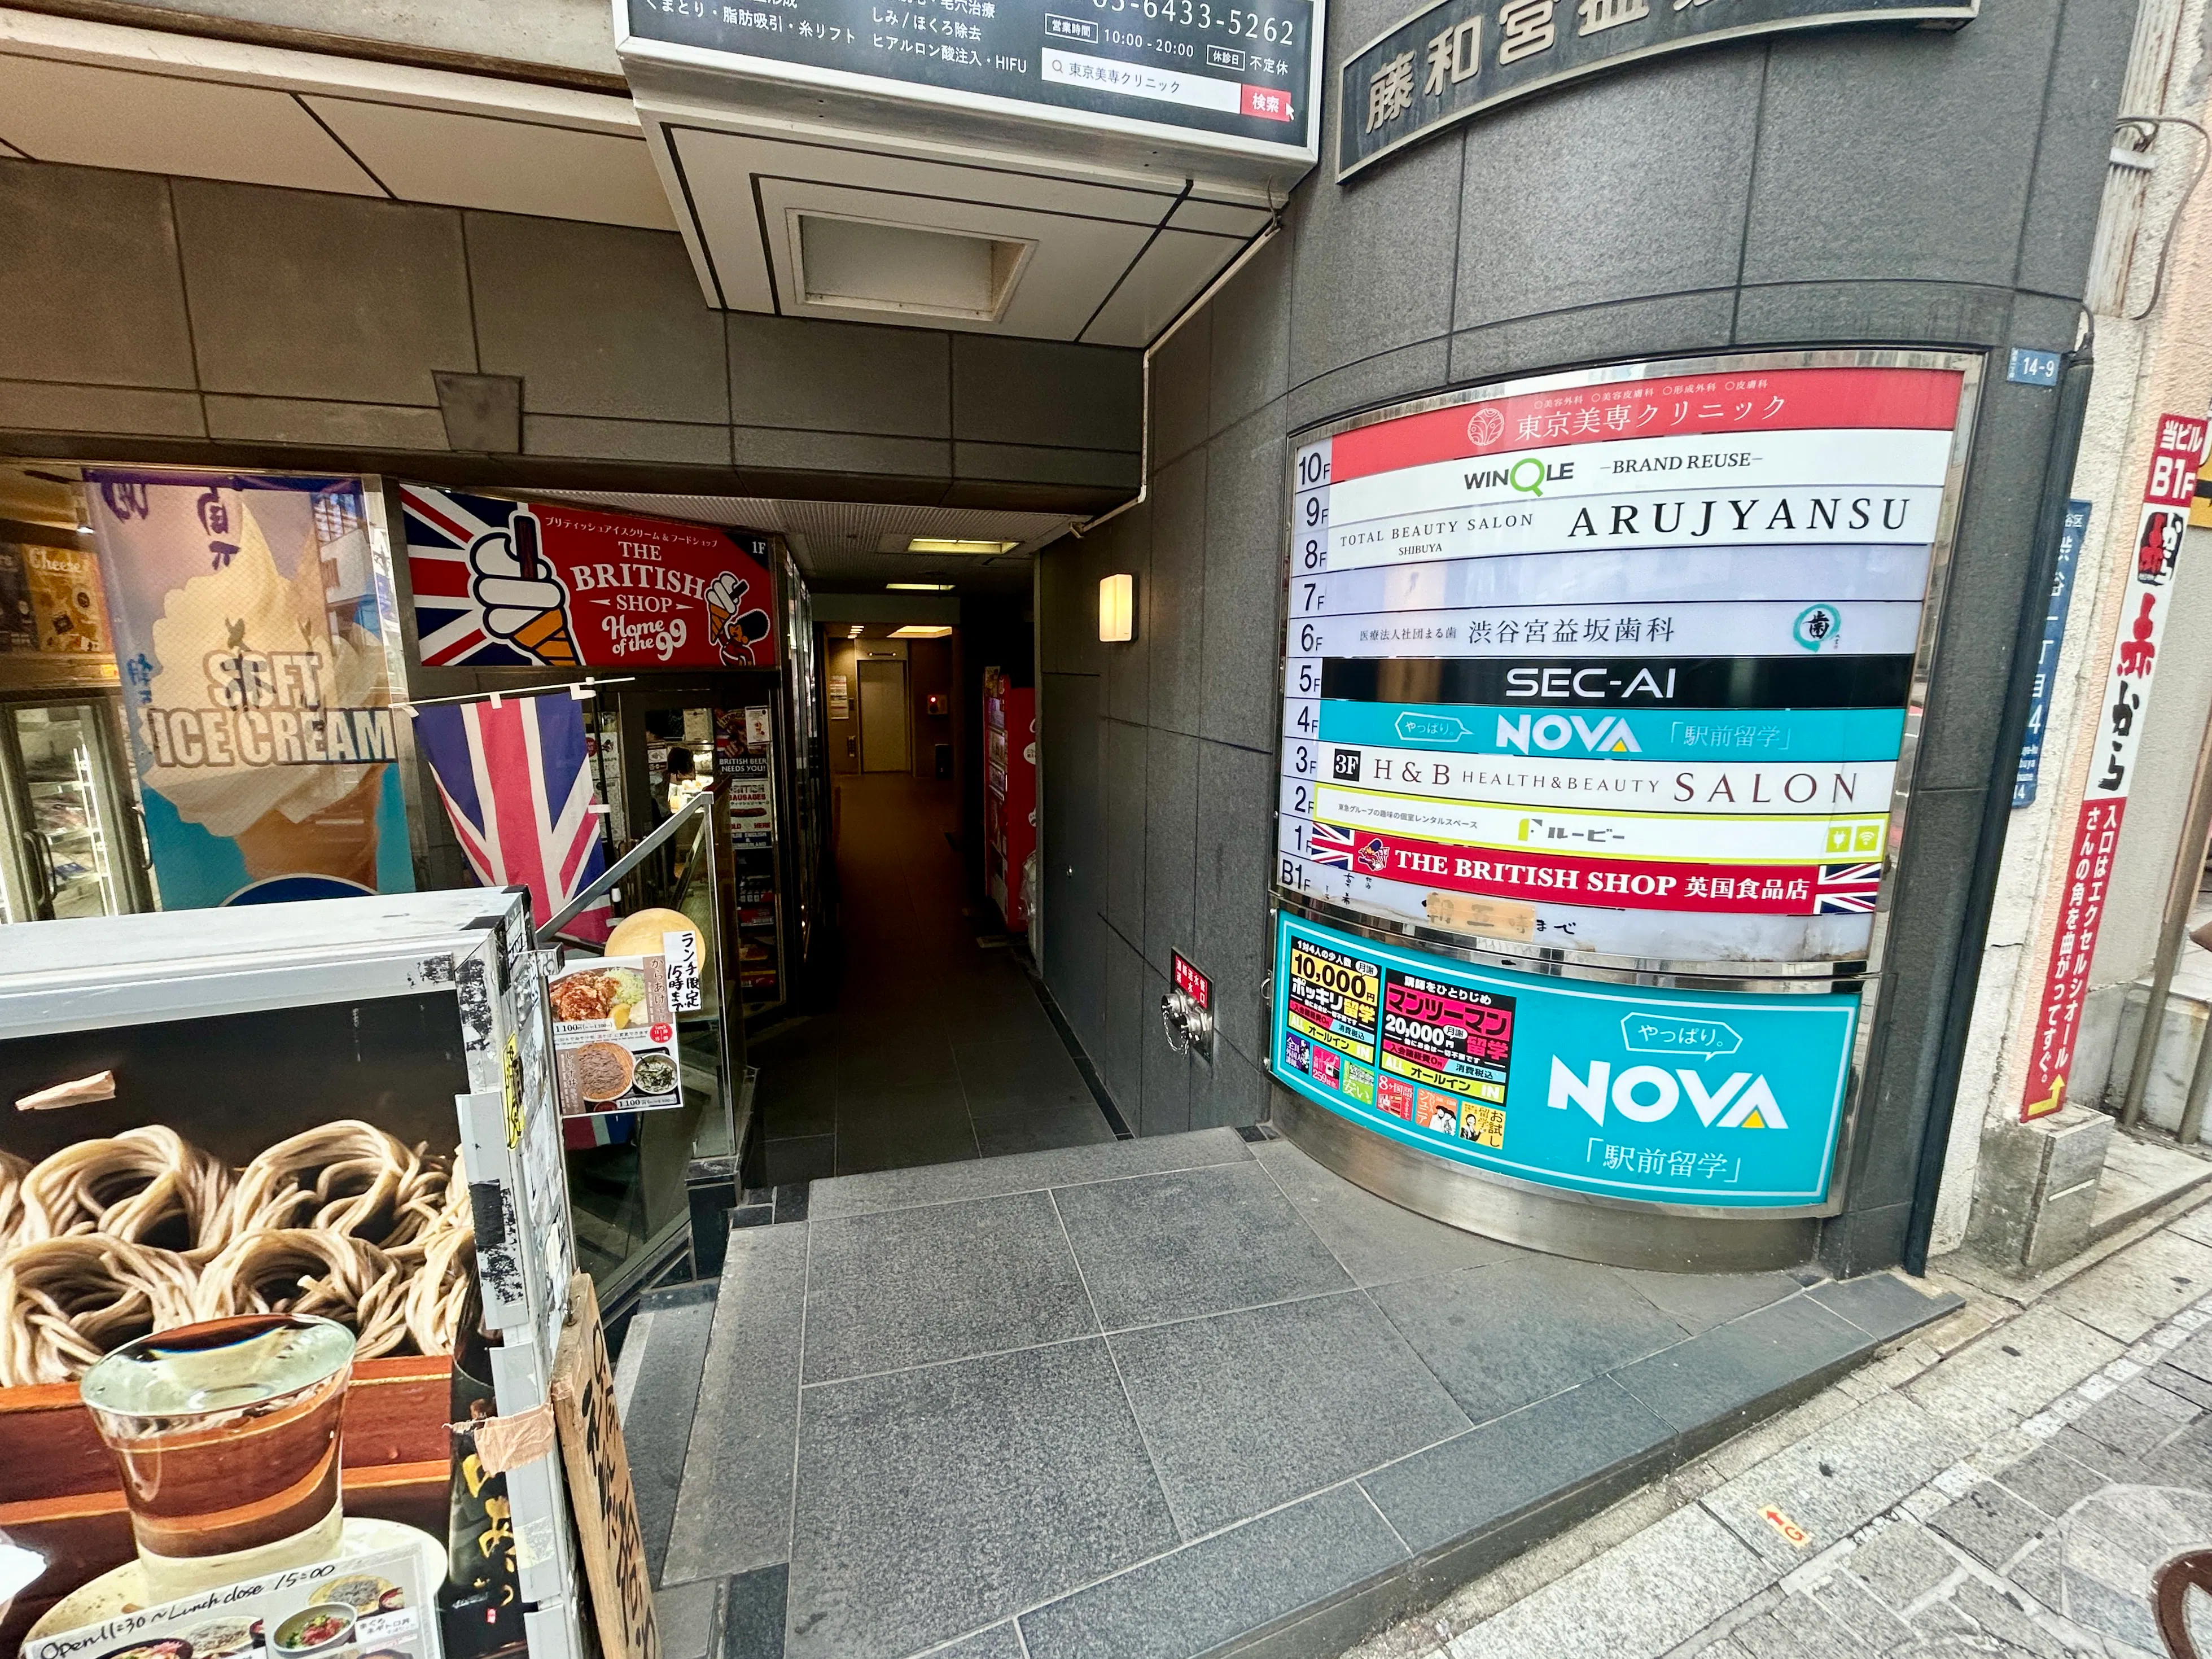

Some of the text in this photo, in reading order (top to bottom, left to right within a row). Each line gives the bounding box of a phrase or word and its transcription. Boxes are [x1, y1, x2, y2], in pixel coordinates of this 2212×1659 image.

[1052, 19, 1091, 38] 営業時間
[1105, 29, 1194, 58] 10:00 20:00
[1212, 50, 1240, 66] 休診日
[1249, 55, 1289, 76] 不定休
[1068, 62, 1181, 94] 東京美専クリニック
[1252, 92, 1280, 113] 検索
[2022, 356, 2055, 378] 14-9
[1514, 395, 1786, 442] 東京美専クリニック
[2160, 419, 2204, 453] 当ビル
[1298, 452, 1331, 485] 10F
[1464, 457, 1575, 497] WINQLE
[2150, 456, 2196, 500] B1F
[1306, 497, 1329, 527] 9F
[1567, 497, 1911, 538] ARUJYANSU
[545, 516, 660, 541] ブリティッシュアイスクリーム
[671, 533, 718, 549] フードショップ
[1340, 513, 1534, 548] TOTAL BEAUTY SALON
[617, 540, 662, 561] THE
[751, 540, 766, 555] 1F
[1304, 539, 1328, 569] 8F
[1398, 542, 1443, 556] SHIBUYA
[570, 563, 706, 601] BRITISH
[616, 594, 673, 614] SHOP
[1303, 583, 1326, 612] 7F
[601, 616, 665, 641] Home
[611, 618, 687, 660] of the 99
[1300, 624, 1323, 652] 6F
[1360, 617, 1675, 645] 医療法人社団まる歯 渋谷宮益坂歯科
[203, 651, 324, 710] SOFT
[1299, 664, 1321, 693] 5F
[1505, 667, 1676, 698] SEC-AI
[1297, 706, 1319, 733] 4F
[1496, 713, 1642, 755] NOVA
[148, 707, 397, 767] ICE CREAM
[1295, 746, 1317, 774] 3F
[1334, 754, 1360, 775] 3F
[1295, 785, 1315, 814] 2F
[1673, 773, 1858, 803] SALON
[1281, 860, 1311, 890] B1F
[1395, 849, 1677, 896] THE BRITISH SHOP
[1684, 876, 1810, 900] 英国食品店
[2055, 804, 2117, 1071] 入口はエクセルシオール
[681, 932, 700, 1008] ランチ限定
[1292, 977, 1376, 1024] ポッキリ留学
[1388, 990, 1509, 1035] マンツーマン
[1308, 1024, 1350, 1050] オールイン
[1466, 1035, 1509, 1061] 留学
[1385, 1054, 1405, 1074] ALL
[1455, 1063, 1494, 1080] 消費税込
[1410, 1067, 1471, 1092] オールイン
[1481, 1084, 1500, 1100] IN
[1547, 1053, 1789, 1130] NOVA
[1488, 1110, 1504, 1148] お試し
[1587, 1137, 1741, 1183] 「駅前留学」
[168, 1592, 221, 1622] Lunch
[222, 1583, 264, 1606] close
